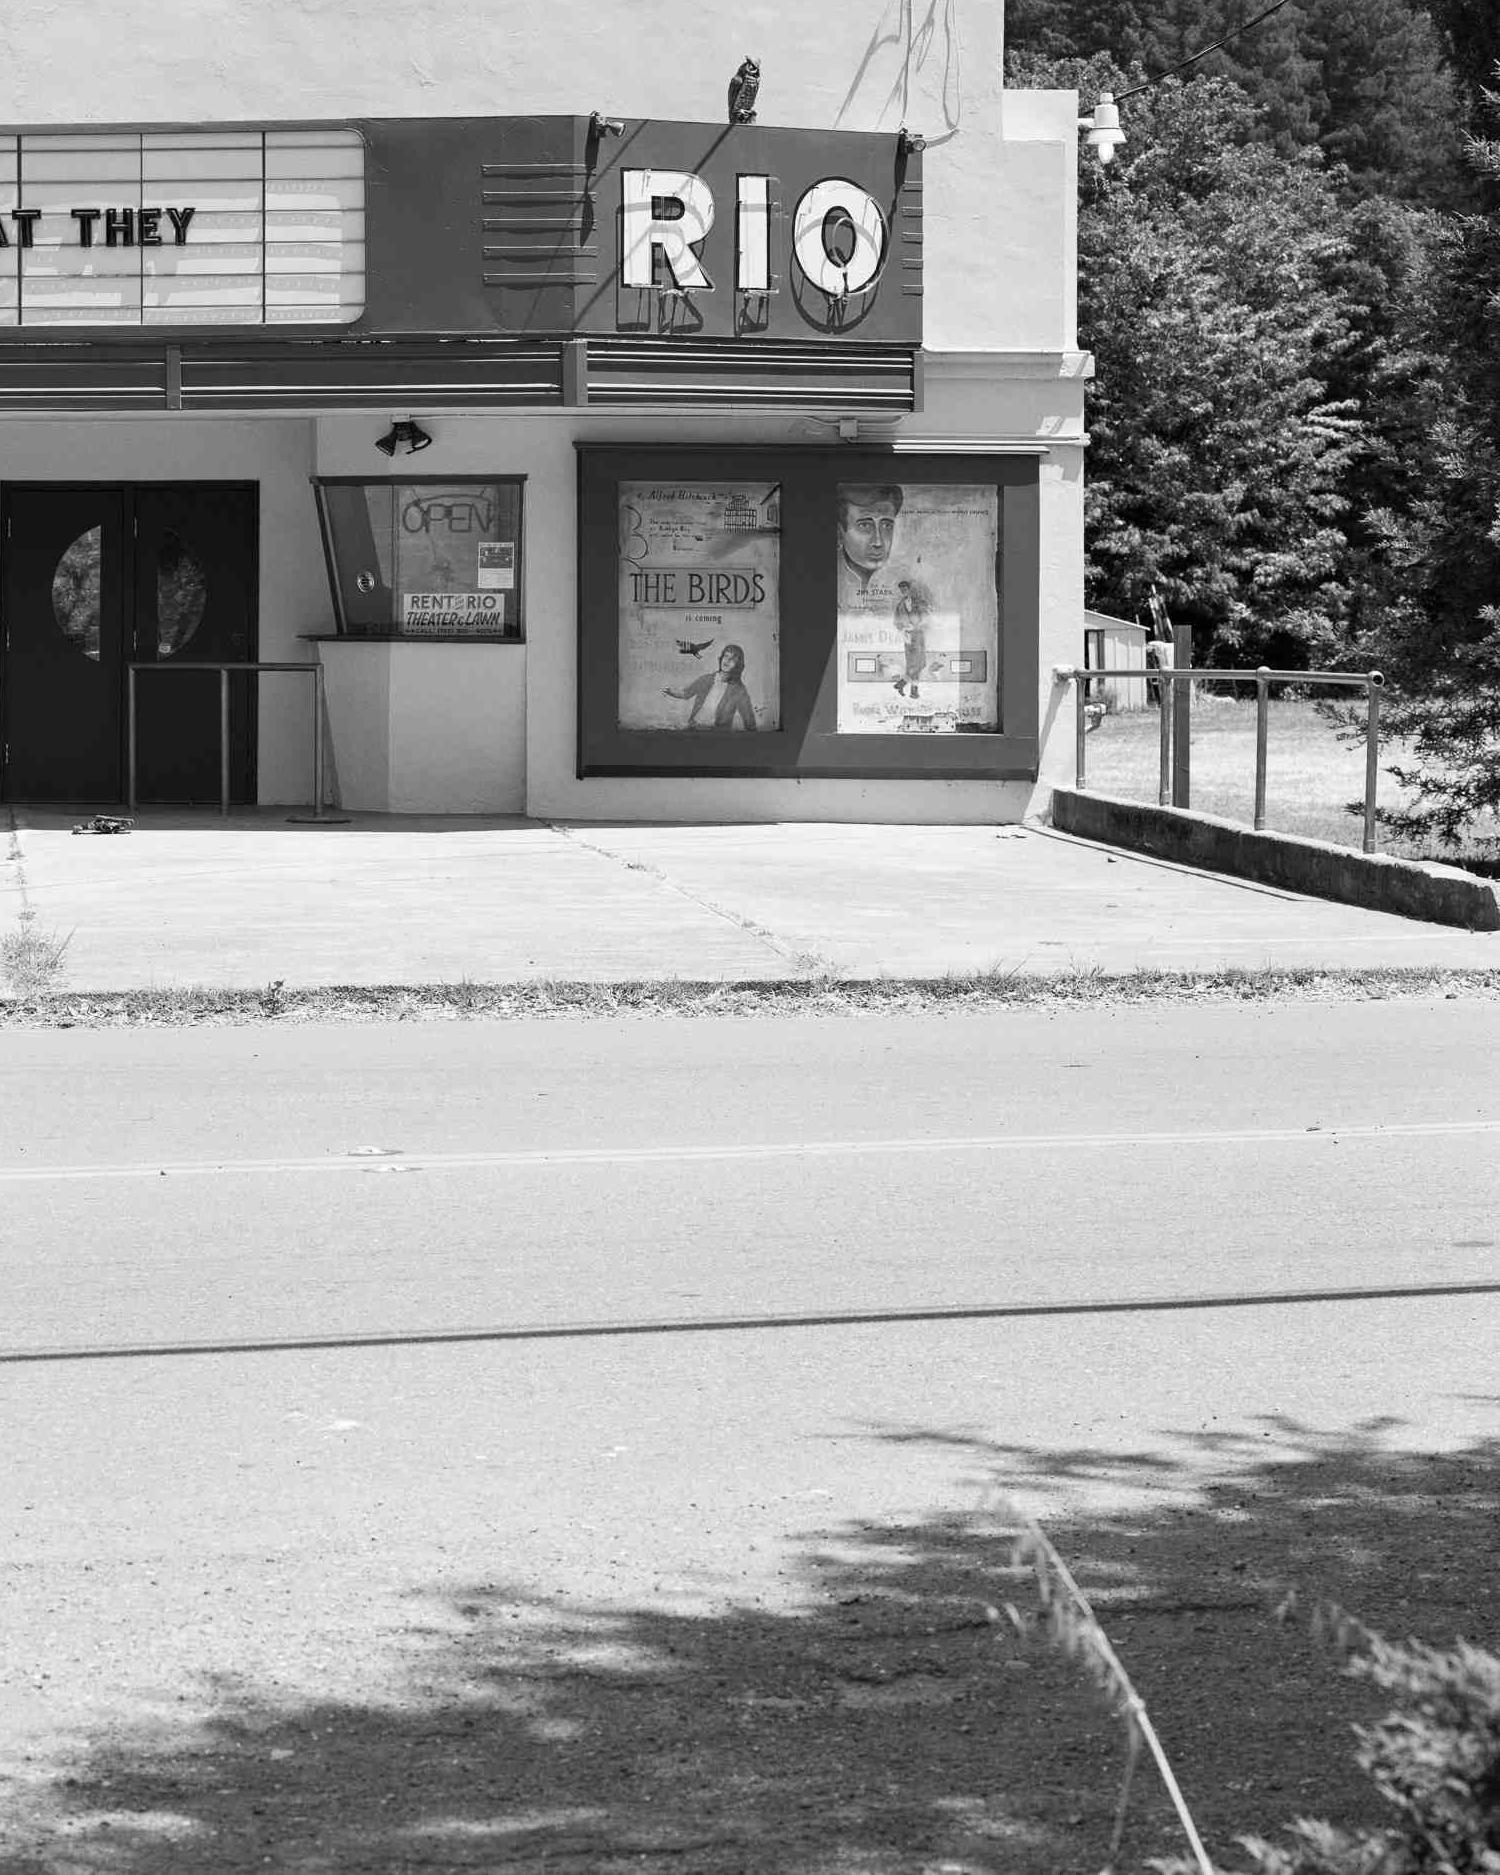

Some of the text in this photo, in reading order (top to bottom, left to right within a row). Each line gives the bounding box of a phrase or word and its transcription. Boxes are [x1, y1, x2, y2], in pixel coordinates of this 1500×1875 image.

[70, 206, 196, 247] THEY
[619, 167, 890, 295] RIO
[402, 500, 492, 533] OPEN
[411, 595, 454, 609] RENT
[467, 595, 496, 609] RIO
[630, 573, 765, 604] THE BIRDS
[407, 611, 458, 626] THEATER
[465, 611, 501, 626] LAWN
